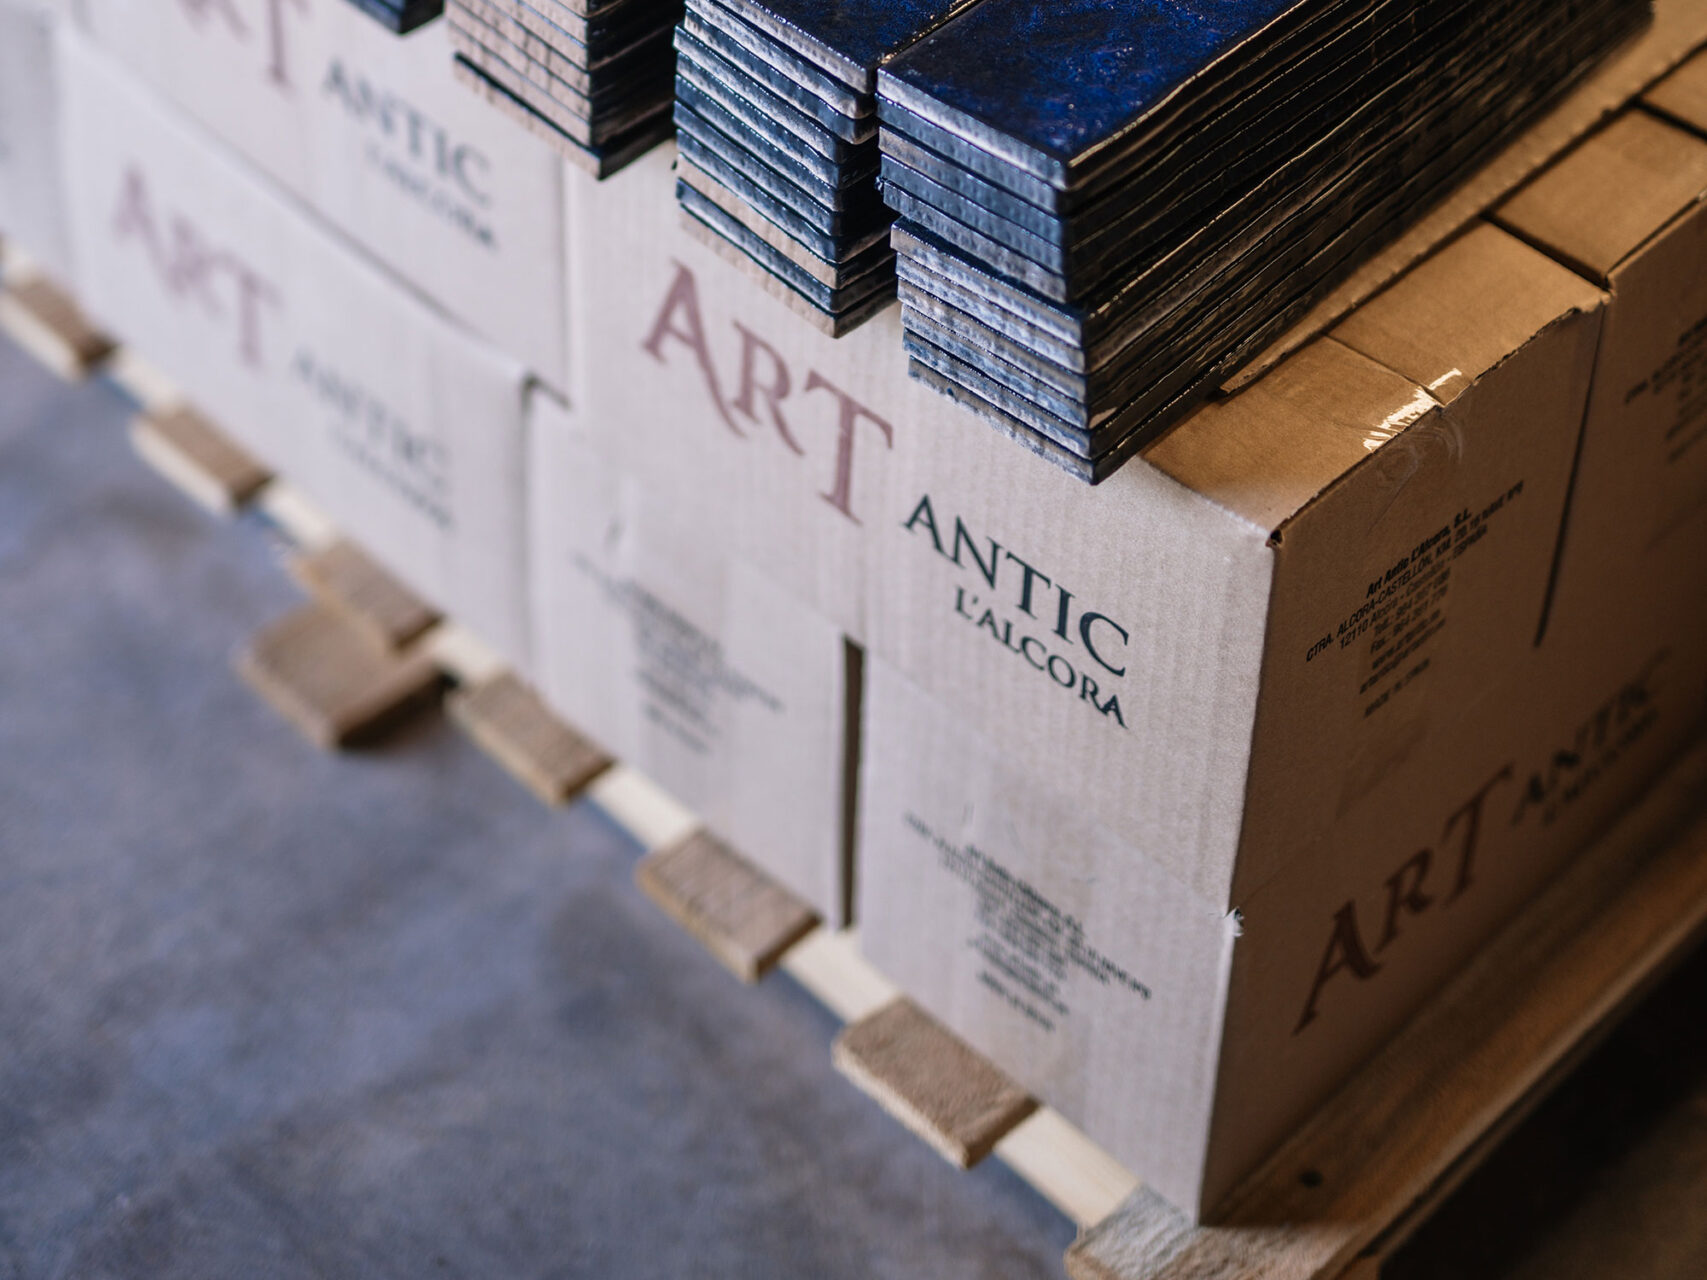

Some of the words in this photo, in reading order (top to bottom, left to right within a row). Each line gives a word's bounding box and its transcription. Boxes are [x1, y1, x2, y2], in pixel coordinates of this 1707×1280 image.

[320, 56, 492, 206] ANTIC
[643, 260, 893, 524] ART
[904, 494, 1130, 677] ANTIC
[955, 586, 1128, 729] L'ALCORA
[1306, 632, 1333, 663] CTRA.
[1340, 617, 1368, 650] 12110
[1366, 575, 1382, 599] Art
[1294, 762, 1512, 1036] ART
